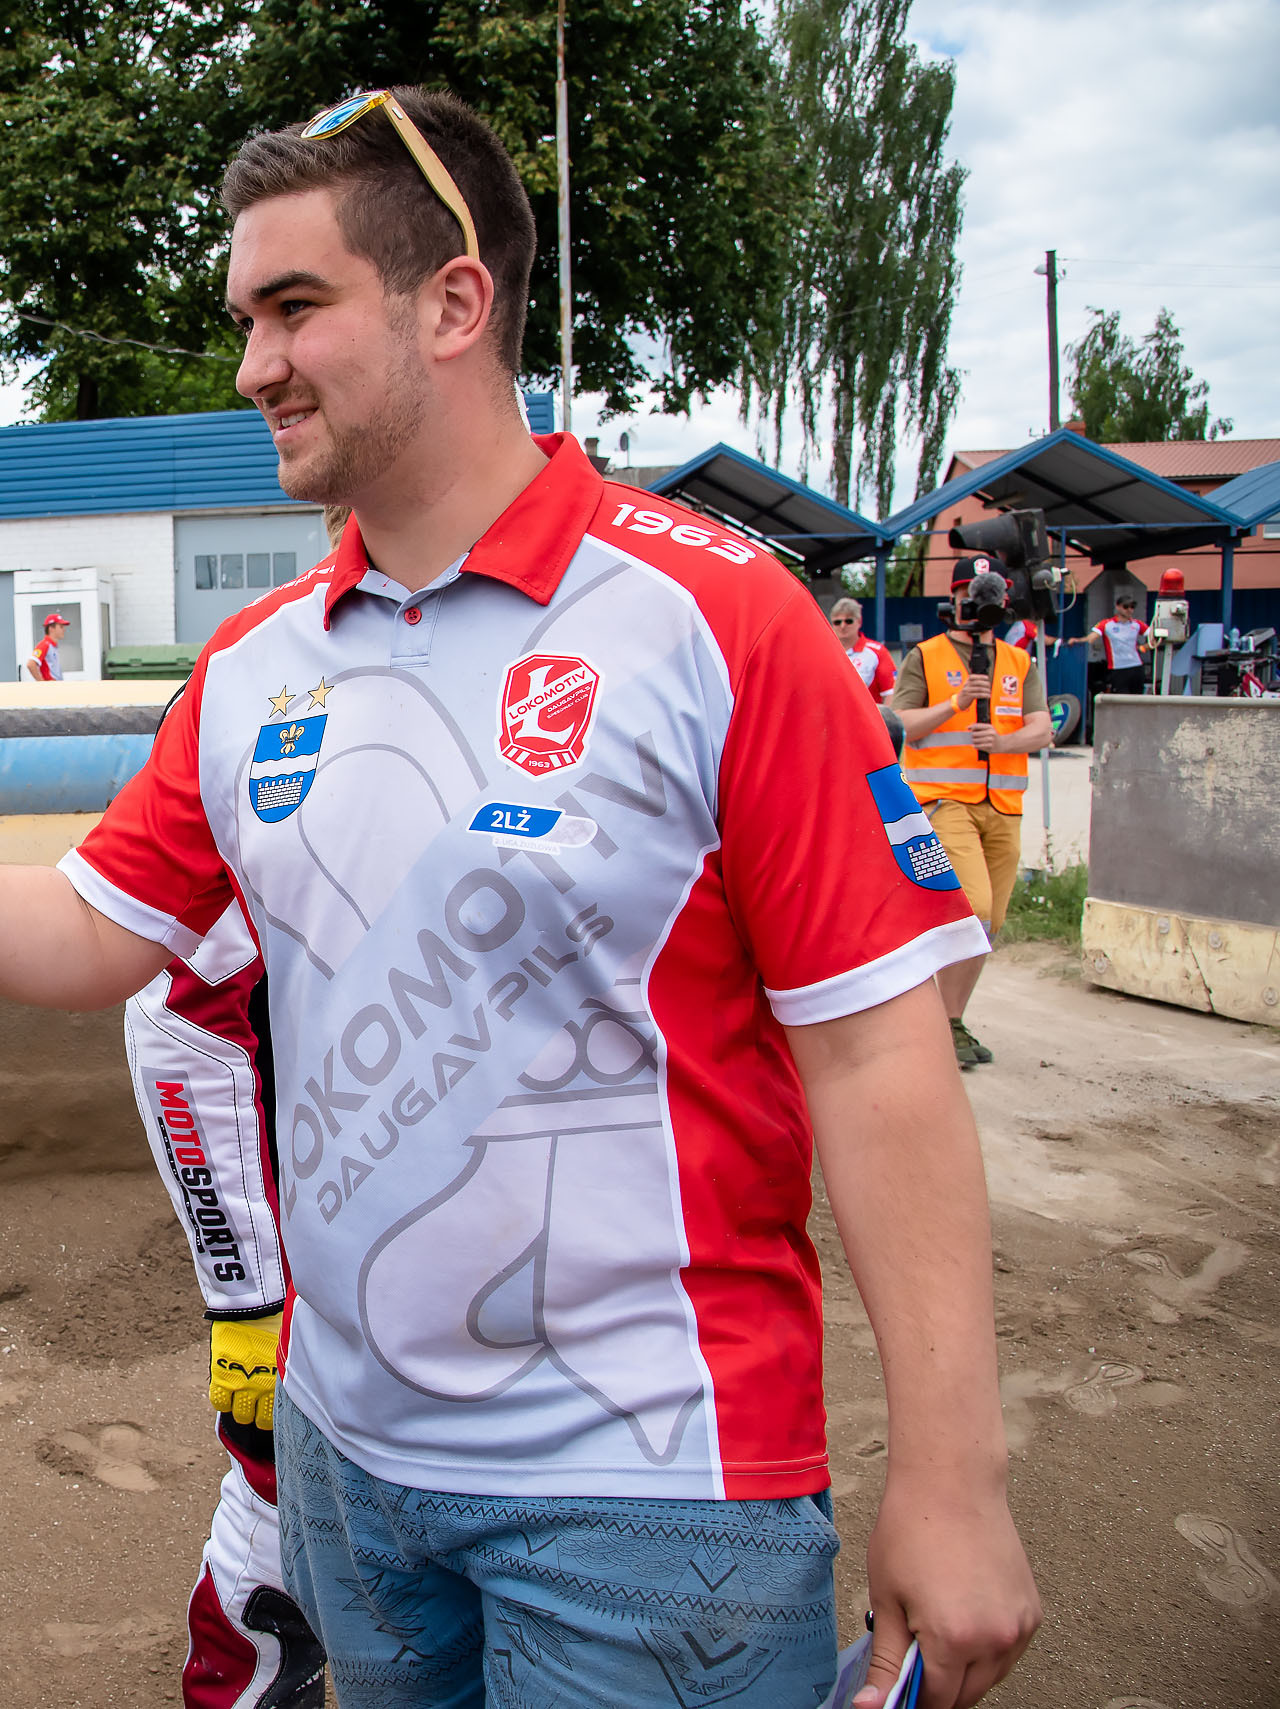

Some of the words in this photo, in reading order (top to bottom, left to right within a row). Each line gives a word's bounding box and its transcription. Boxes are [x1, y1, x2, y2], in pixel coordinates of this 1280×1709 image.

[611, 504, 757, 564] 1963
[509, 670, 586, 719] LOKOMOTIV
[547, 686, 591, 712] DAUGAVPILS
[528, 760, 551, 768] 1963
[490, 809, 532, 832] 2LŻ
[317, 902, 615, 1225] DAUGAVPILS
[156, 1081, 245, 1282] MOTOSPORTS
